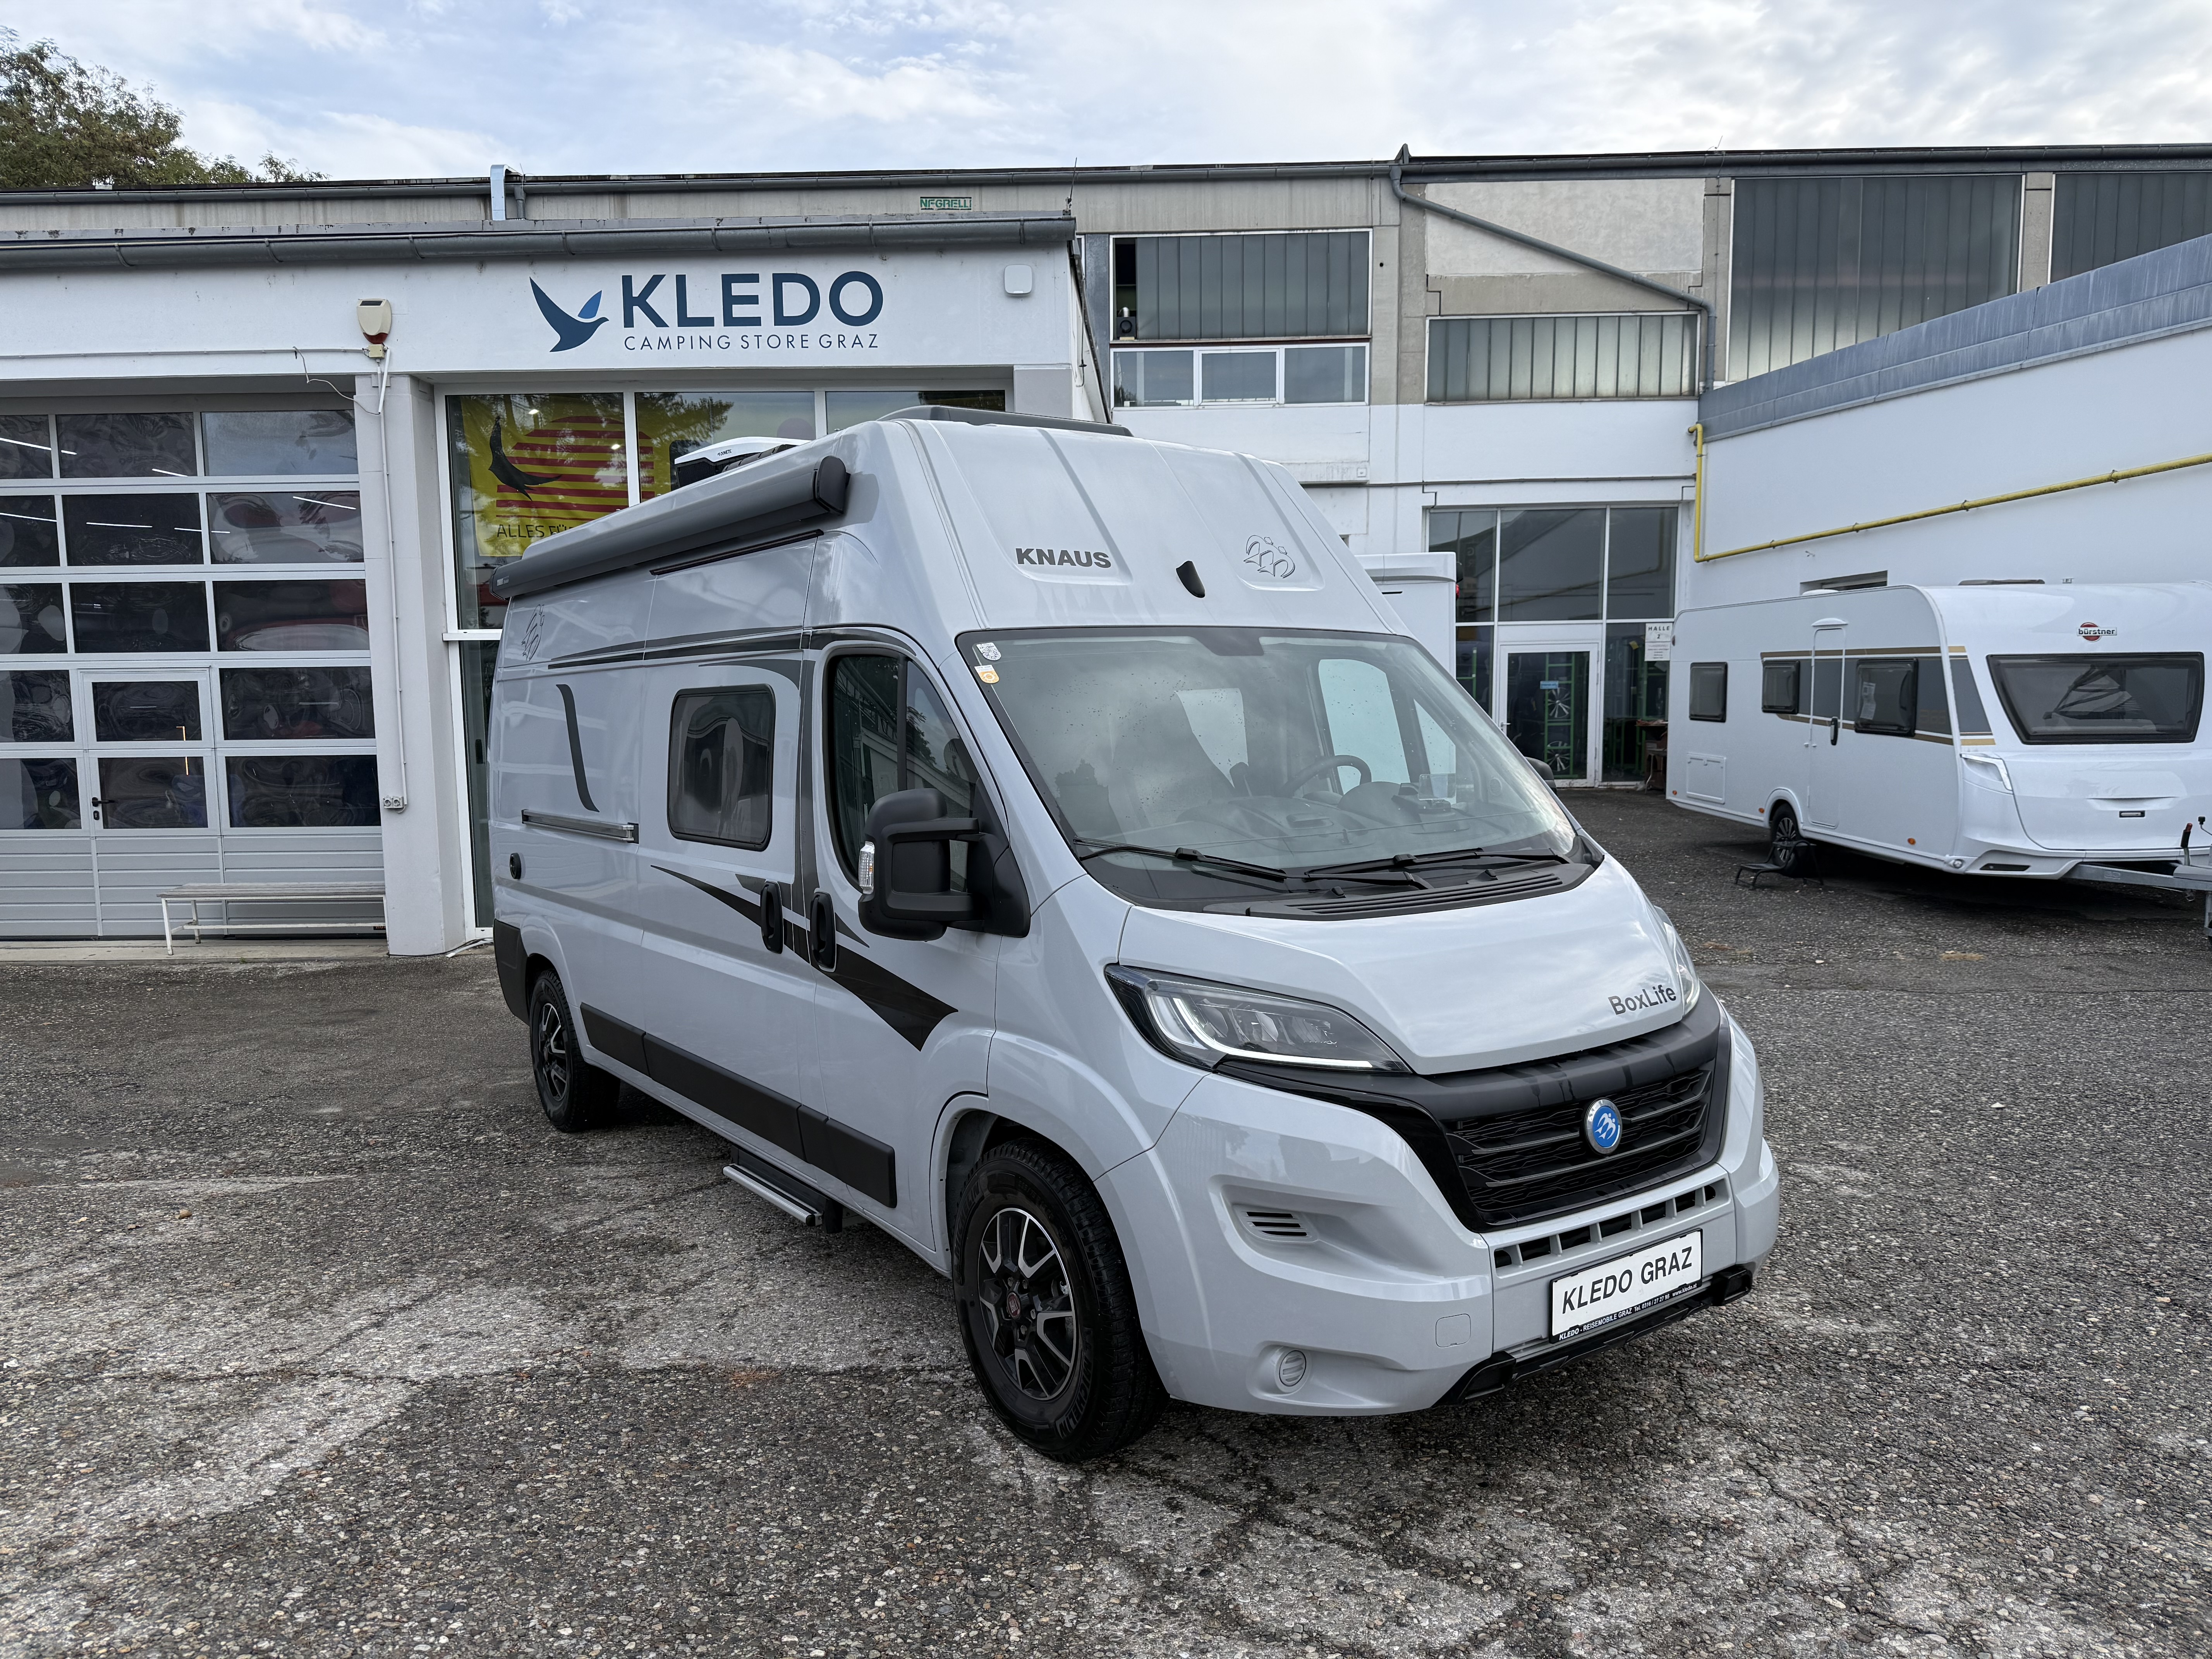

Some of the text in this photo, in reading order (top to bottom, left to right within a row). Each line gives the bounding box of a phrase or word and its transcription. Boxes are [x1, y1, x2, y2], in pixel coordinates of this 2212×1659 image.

[622, 271, 883, 328] KLEDO
[624, 333, 878, 350] CAMPING STORE GRAZ
[497, 524, 544, 538] ALLES
[1015, 548, 1111, 568] KNAUS
[1608, 984, 1676, 1015] BoxLife
[955, 1179, 980, 1261] MICHELIN
[1562, 1246, 1692, 1314] KLEDO GRAZ
[1559, 1328, 1579, 1341] KLEDO
[1583, 1314, 1617, 1332] REISEMOBILE
[1618, 1308, 1632, 1318] GRAZ
[1672, 1283, 1697, 1297] www.kledo.at
[1057, 1354, 1092, 1439] MICHELIN
